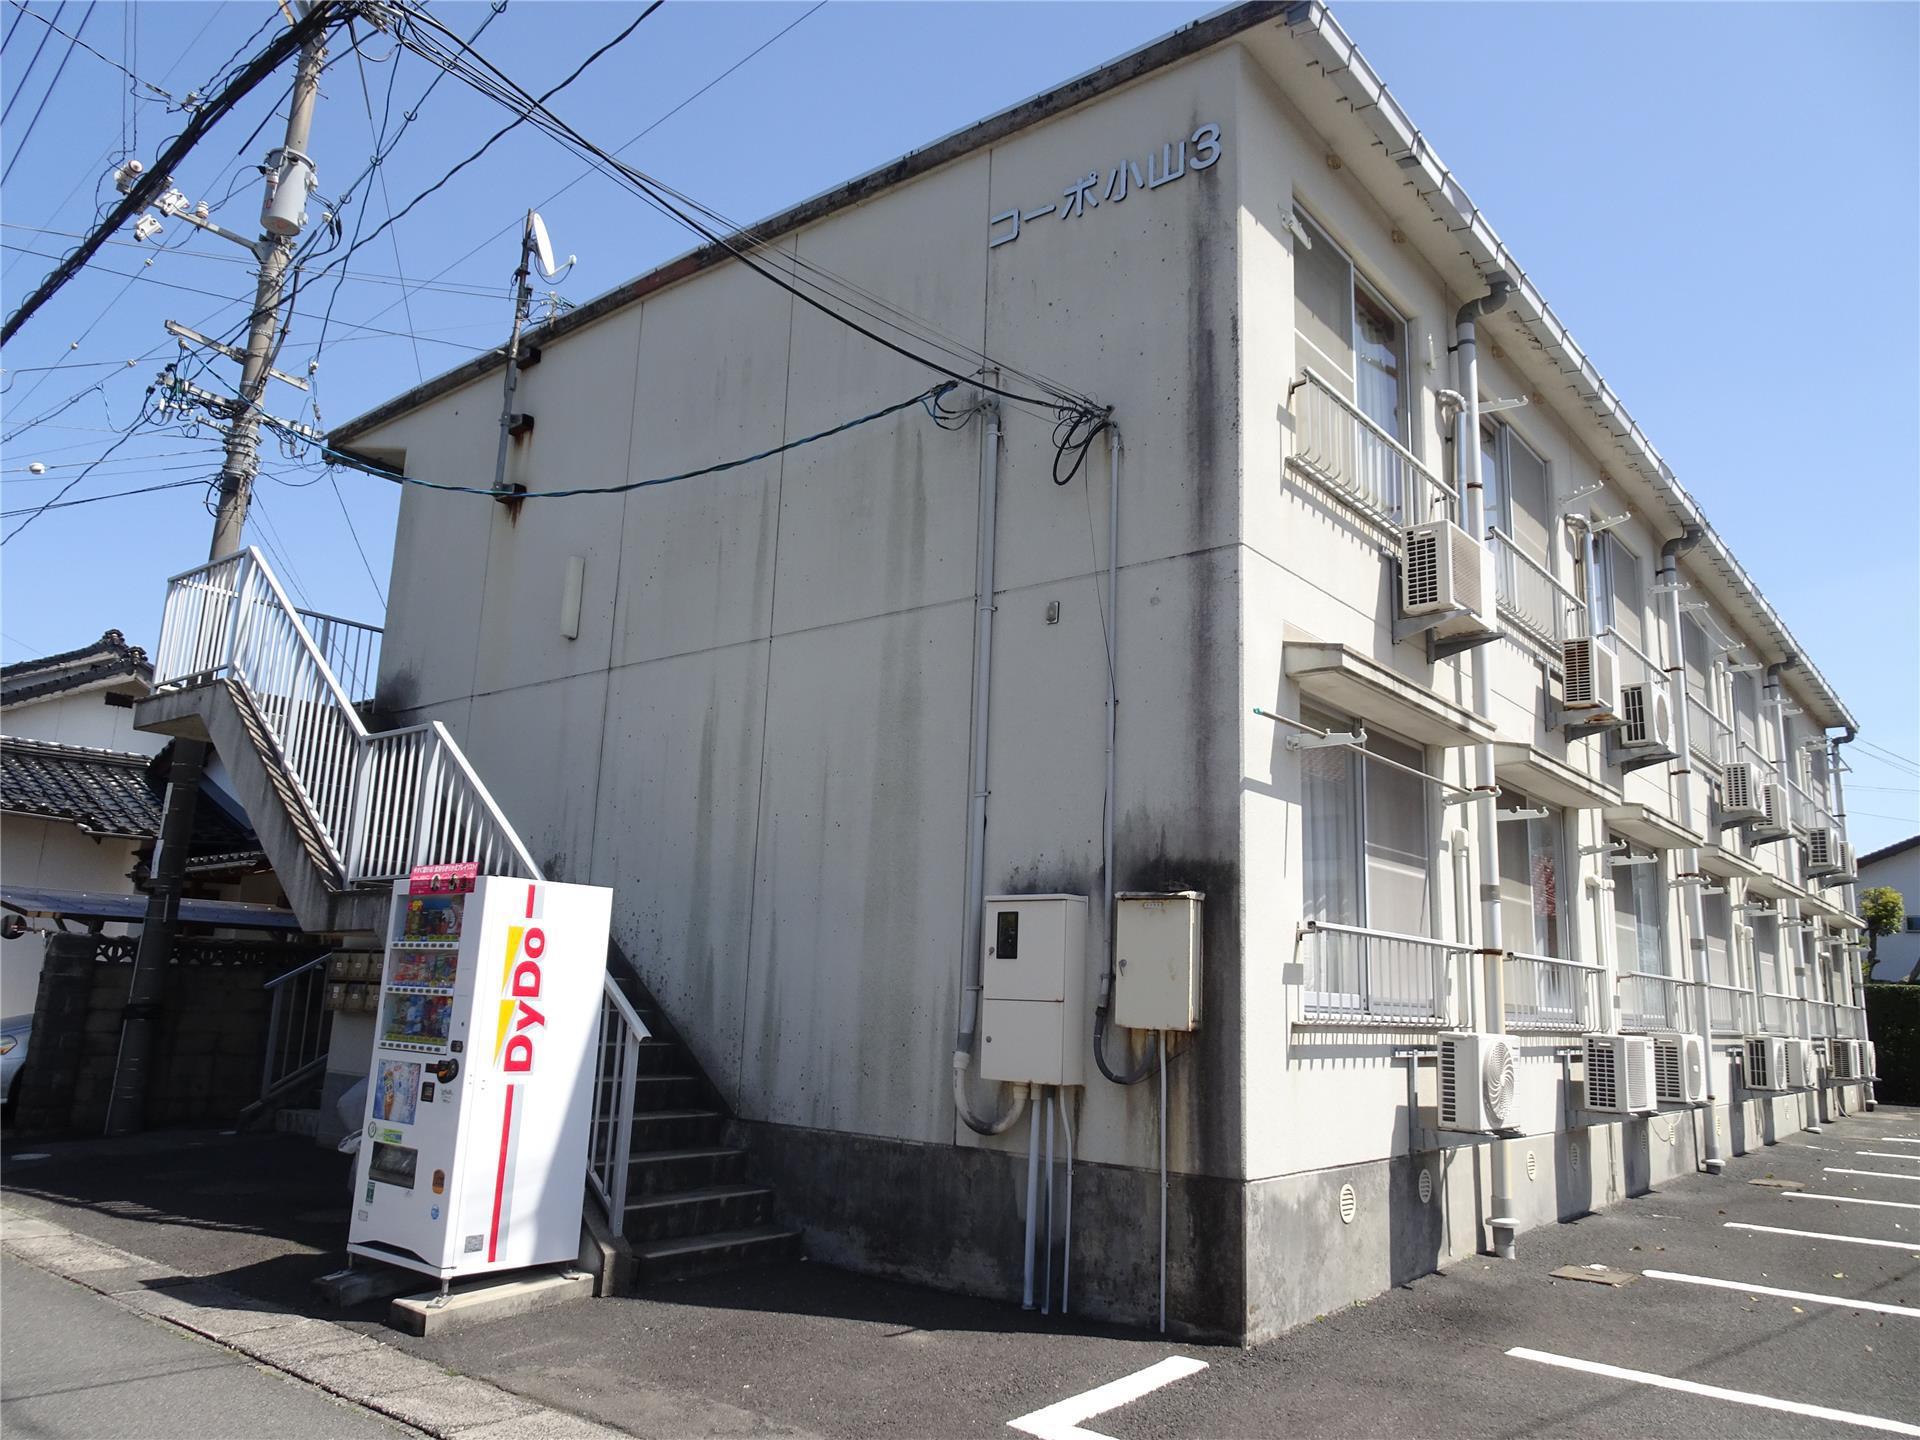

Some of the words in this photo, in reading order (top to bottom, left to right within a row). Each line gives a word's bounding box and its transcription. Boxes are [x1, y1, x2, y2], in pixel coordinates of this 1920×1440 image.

[990, 123, 1221, 248] コーポ小山3
[504, 927, 545, 1072] DyDo
